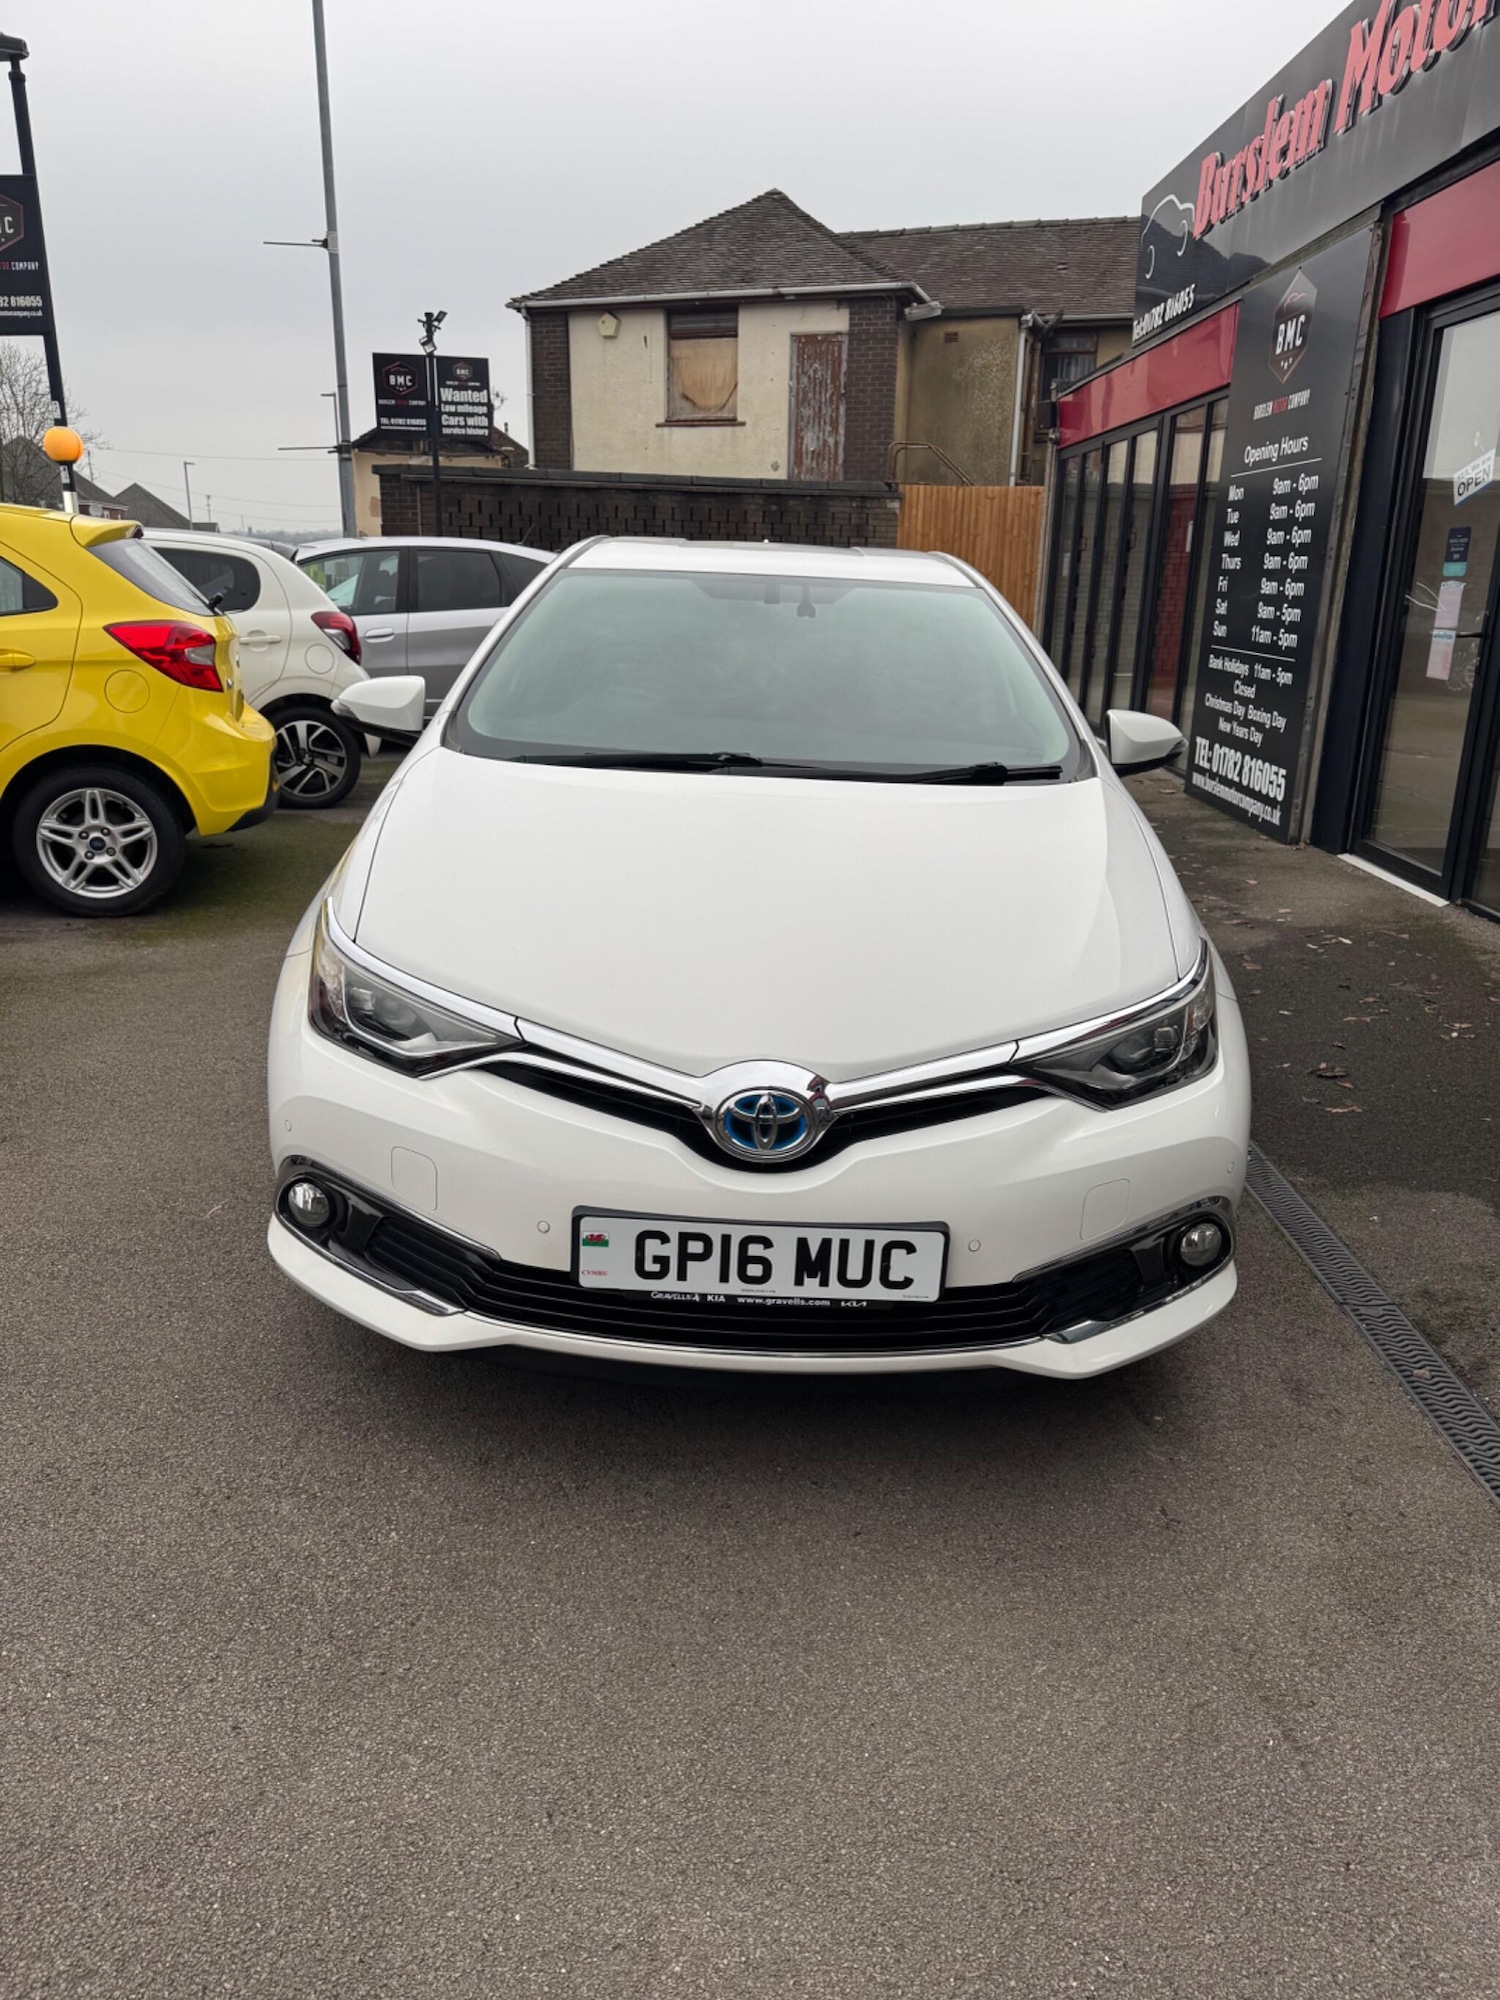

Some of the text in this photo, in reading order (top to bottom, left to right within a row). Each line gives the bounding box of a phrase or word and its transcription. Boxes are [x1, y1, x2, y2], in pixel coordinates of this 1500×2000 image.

[1192, 0, 1494, 240] Burslem Moto
[10, 295, 42, 307] 816055
[1275, 314, 1306, 355] BMC
[389, 375, 412, 386] BMC
[440, 387, 488, 403] Wanted
[441, 403, 488, 414] Low mileage
[441, 414, 488, 427] Cars with
[442, 427, 489, 437] service history
[1244, 436, 1309, 467] Opening Hours
[1228, 485, 1244, 501] Mon
[1272, 477, 1291, 495] 9am
[1298, 473, 1319, 495] 6pm
[1457, 463, 1492, 497] OPEN
[1226, 508, 1239, 524] Tue
[1269, 502, 1288, 520] 9am
[1294, 499, 1315, 522] 6pm
[1224, 531, 1240, 547] Wed
[1266, 527, 1285, 545] 9am
[1291, 526, 1312, 548] 6pm
[1221, 553, 1241, 570] Thurs
[1263, 552, 1281, 570] 9am
[1287, 551, 1308, 574] 6pm
[1217, 576, 1228, 592] Fri
[1260, 577, 1278, 595] 9am
[1284, 578, 1305, 600] 6pm
[1215, 598, 1227, 615] Sat
[1257, 601, 1275, 619] 9am
[1281, 603, 1301, 626] 5pm
[1213, 621, 1227, 637] Sun
[1251, 625, 1272, 644] 11am
[1278, 628, 1298, 651] 5pm
[1208, 654, 1224, 670] Bank
[1224, 656, 1250, 679] Holidays
[1254, 662, 1272, 680] 11am
[1276, 666, 1293, 687] 5pm
[1233, 680, 1257, 699] Closed
[1204, 692, 1287, 733] Christmas Day Boxing Day
[1218, 716, 1263, 747] New Years Day
[1194, 736, 1287, 802] TEL: 01782 816055
[634, 1230, 918, 1290] GP16 MUC
[706, 1294, 726, 1303] KIA
[737, 1296, 831, 1307] www.gravells.com
